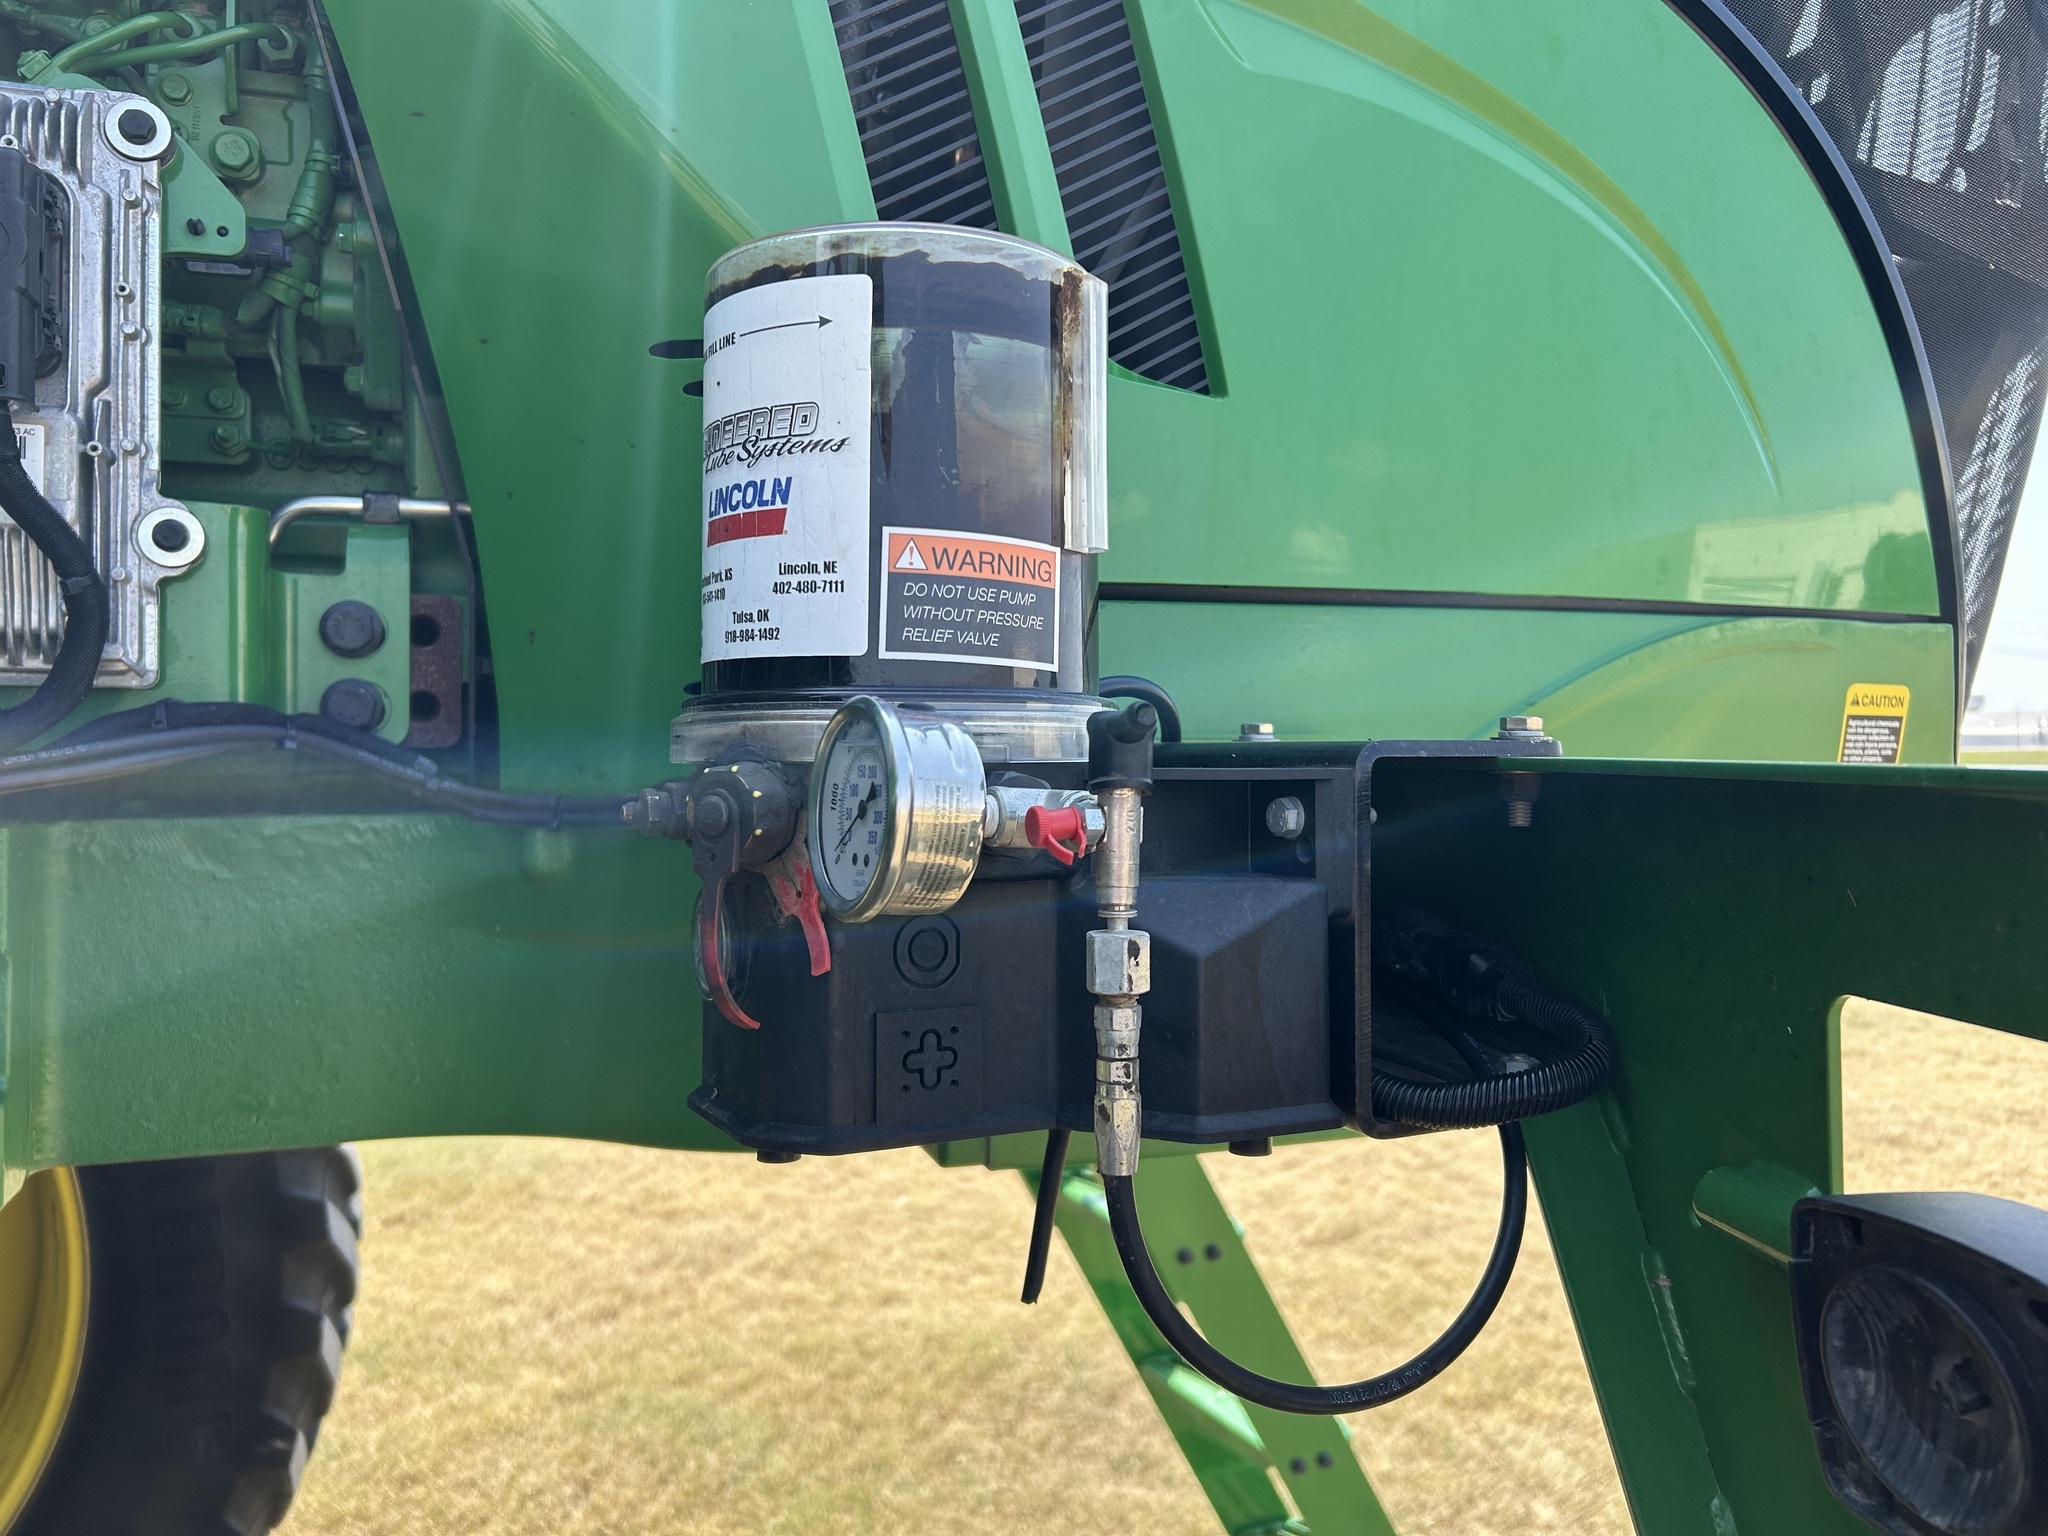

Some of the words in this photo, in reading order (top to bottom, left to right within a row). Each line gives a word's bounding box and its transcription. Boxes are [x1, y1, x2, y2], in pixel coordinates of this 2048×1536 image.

[719, 332, 736, 351] LINE
[22, 428, 36, 436] AC
[703, 447, 735, 474] Lube
[736, 434, 851, 470] Systems
[708, 476, 794, 518] LINCOLN
[778, 561, 821, 576] Lincoln,
[823, 561, 838, 575] NE
[931, 546, 1053, 583] WARNING
[772, 580, 845, 595] 402-480-7111
[903, 582, 928, 597] DO
[931, 584, 966, 599] NOT
[967, 587, 997, 603] USE
[999, 590, 1037, 607] PUMP
[732, 610, 755, 624] Tulsa,
[757, 609, 770, 622] OK
[903, 605, 975, 623] WITHOUT
[976, 610, 1045, 631] PRESSURE
[725, 627, 781, 644] 918-984-1492
[902, 627, 955, 643] RELIEF
[957, 630, 1000, 647] VALVE
[1861, 694, 1905, 709] CAUTION
[830, 783, 840, 812] 1000
